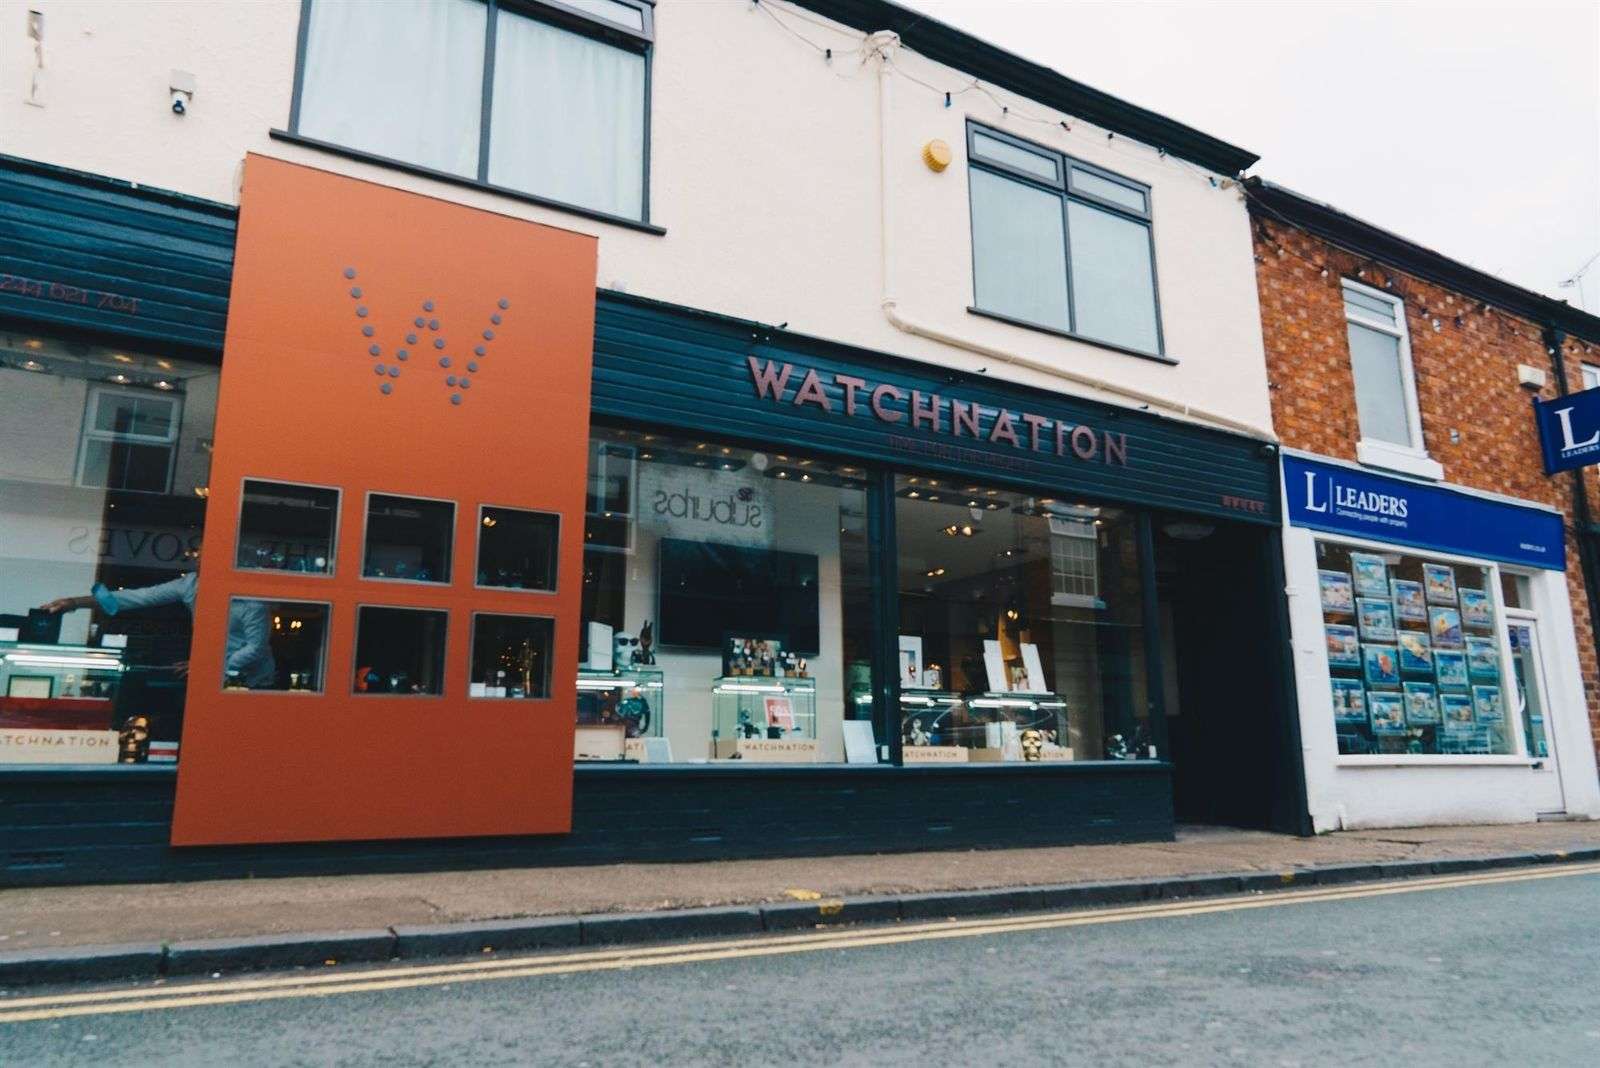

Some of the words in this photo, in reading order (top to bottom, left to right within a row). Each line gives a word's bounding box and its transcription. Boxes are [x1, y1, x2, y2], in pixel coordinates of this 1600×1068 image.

[747, 356, 1129, 466] WATCHNATION
[1553, 406, 1600, 451] L
[1304, 471, 1328, 513] L
[1336, 486, 1409, 519] LEADERS
[743, 742, 816, 752] WATCHNATION
